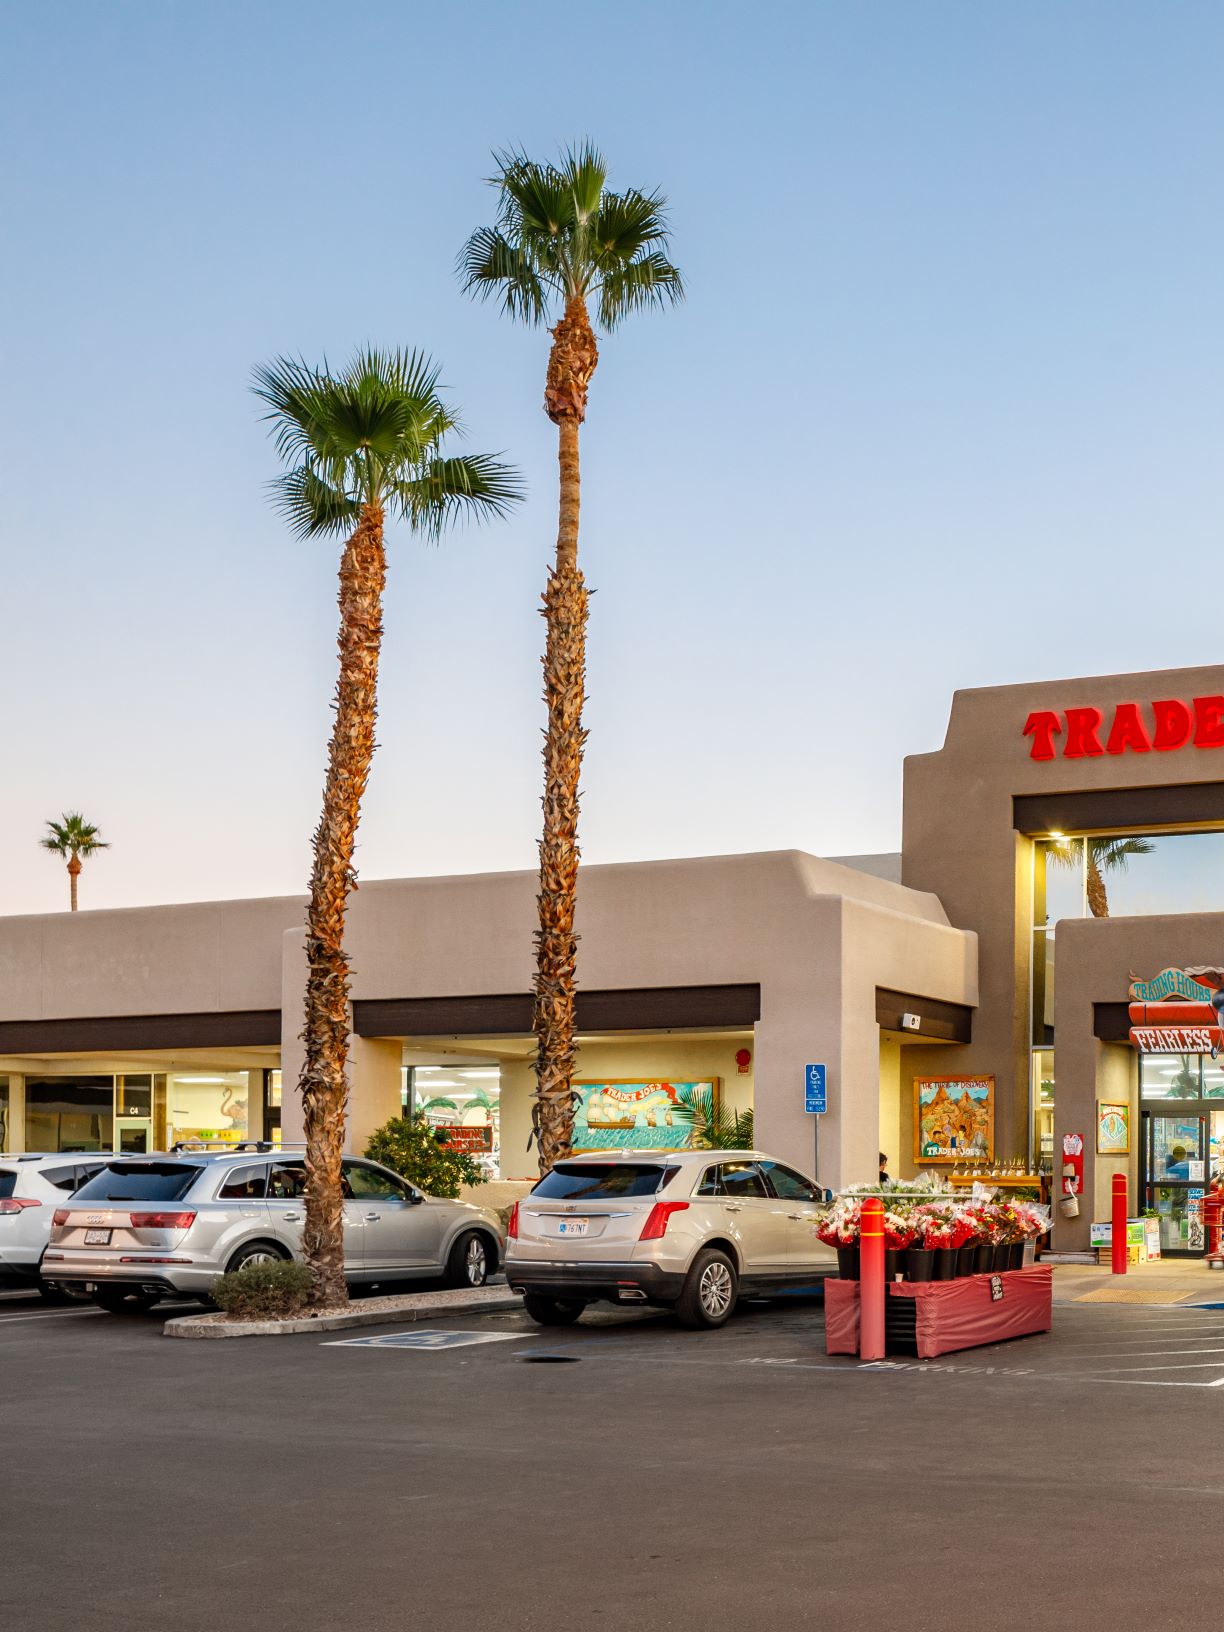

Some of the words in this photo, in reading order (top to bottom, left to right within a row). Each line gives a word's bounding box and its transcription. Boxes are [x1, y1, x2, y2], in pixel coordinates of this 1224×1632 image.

[1134, 970, 1176, 1001] TRADING
[1175, 971, 1212, 1001] HOURS
[1132, 1029, 1213, 1053] FEARLESS
[607, 1087, 637, 1102] TRADER
[129, 1107, 139, 1115] C4
[926, 1147, 957, 1156] TRADER
[857, 1361, 1036, 1376] PARKING
